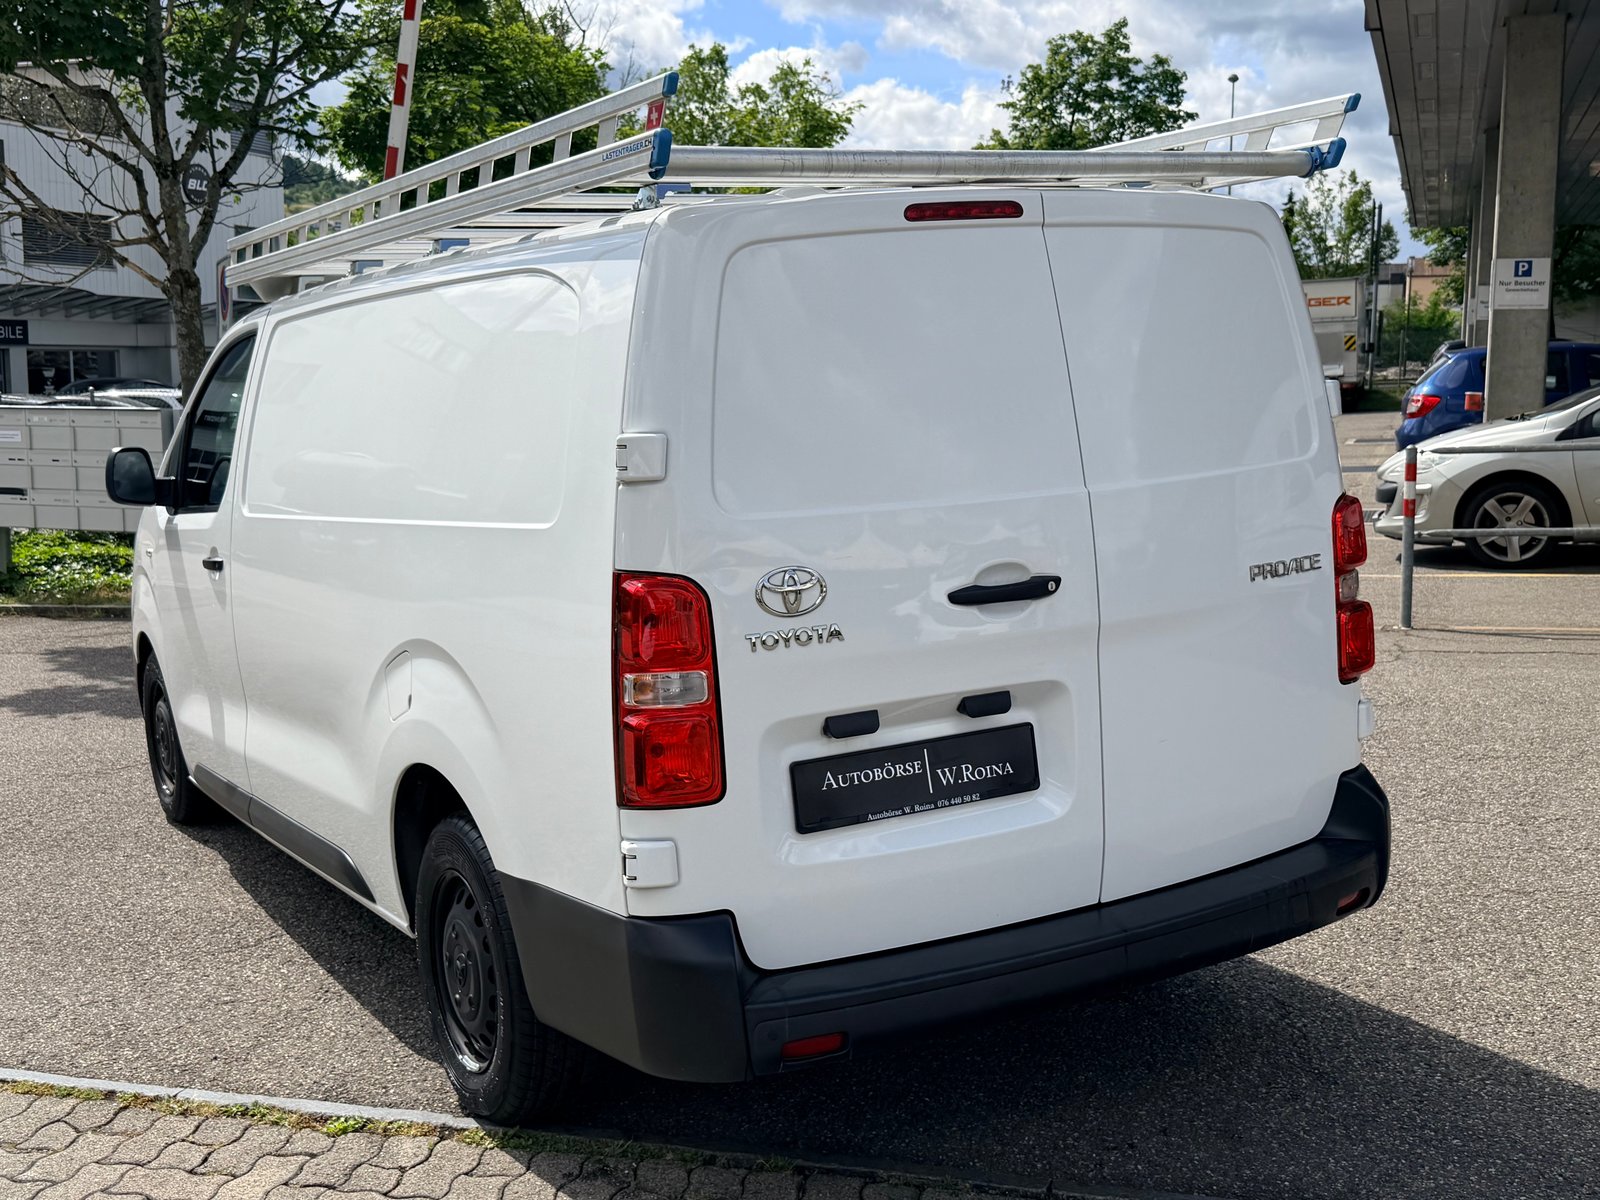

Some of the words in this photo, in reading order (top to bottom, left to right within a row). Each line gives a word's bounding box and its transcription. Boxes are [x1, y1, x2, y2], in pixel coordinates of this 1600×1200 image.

[1518, 262, 1529, 276] P
[1249, 553, 1322, 582] PROACE
[745, 623, 845, 652] TOYOTA
[867, 809, 902, 821] Autobörse
[904, 806, 913, 814] W.
[914, 803, 935, 812] Roina
[937, 799, 949, 808] 076
[950, 797, 962, 805] 440
[963, 795, 971, 803] 50
[972, 793, 980, 802] 82
